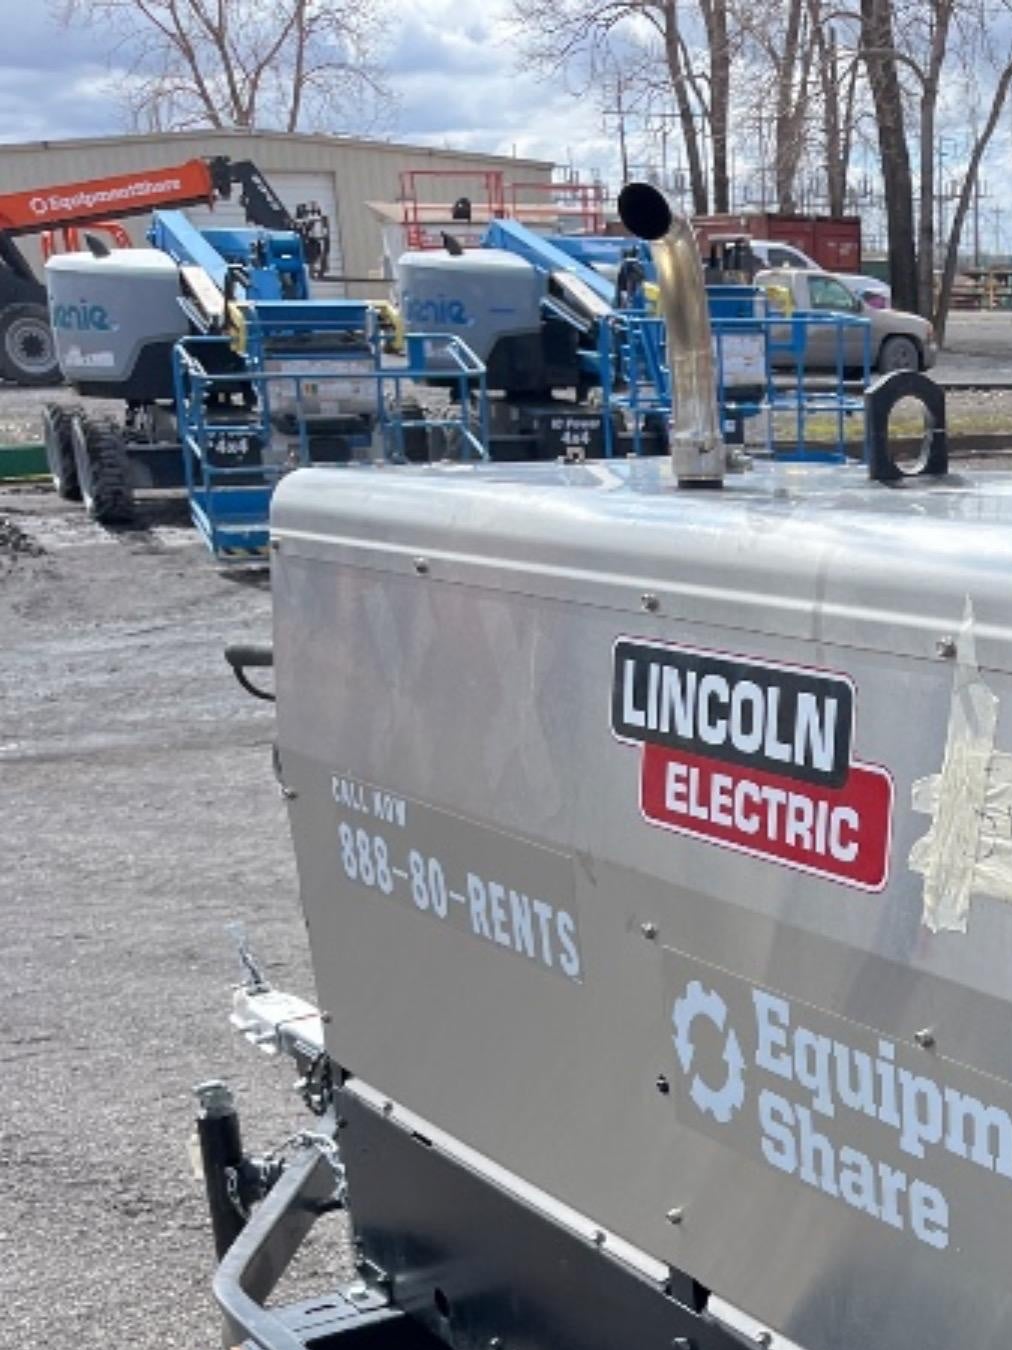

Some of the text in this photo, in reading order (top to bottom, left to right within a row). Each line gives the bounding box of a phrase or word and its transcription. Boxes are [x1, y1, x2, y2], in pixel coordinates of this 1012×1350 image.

[50, 179, 181, 210] EquipmentShare
[622, 658, 838, 773] LINCOLN
[331, 776, 407, 827] CALL NOW
[665, 761, 860, 863] ELECTRIC
[338, 821, 580, 977] 888-80-RENTS
[757, 1088, 950, 1250] Share
